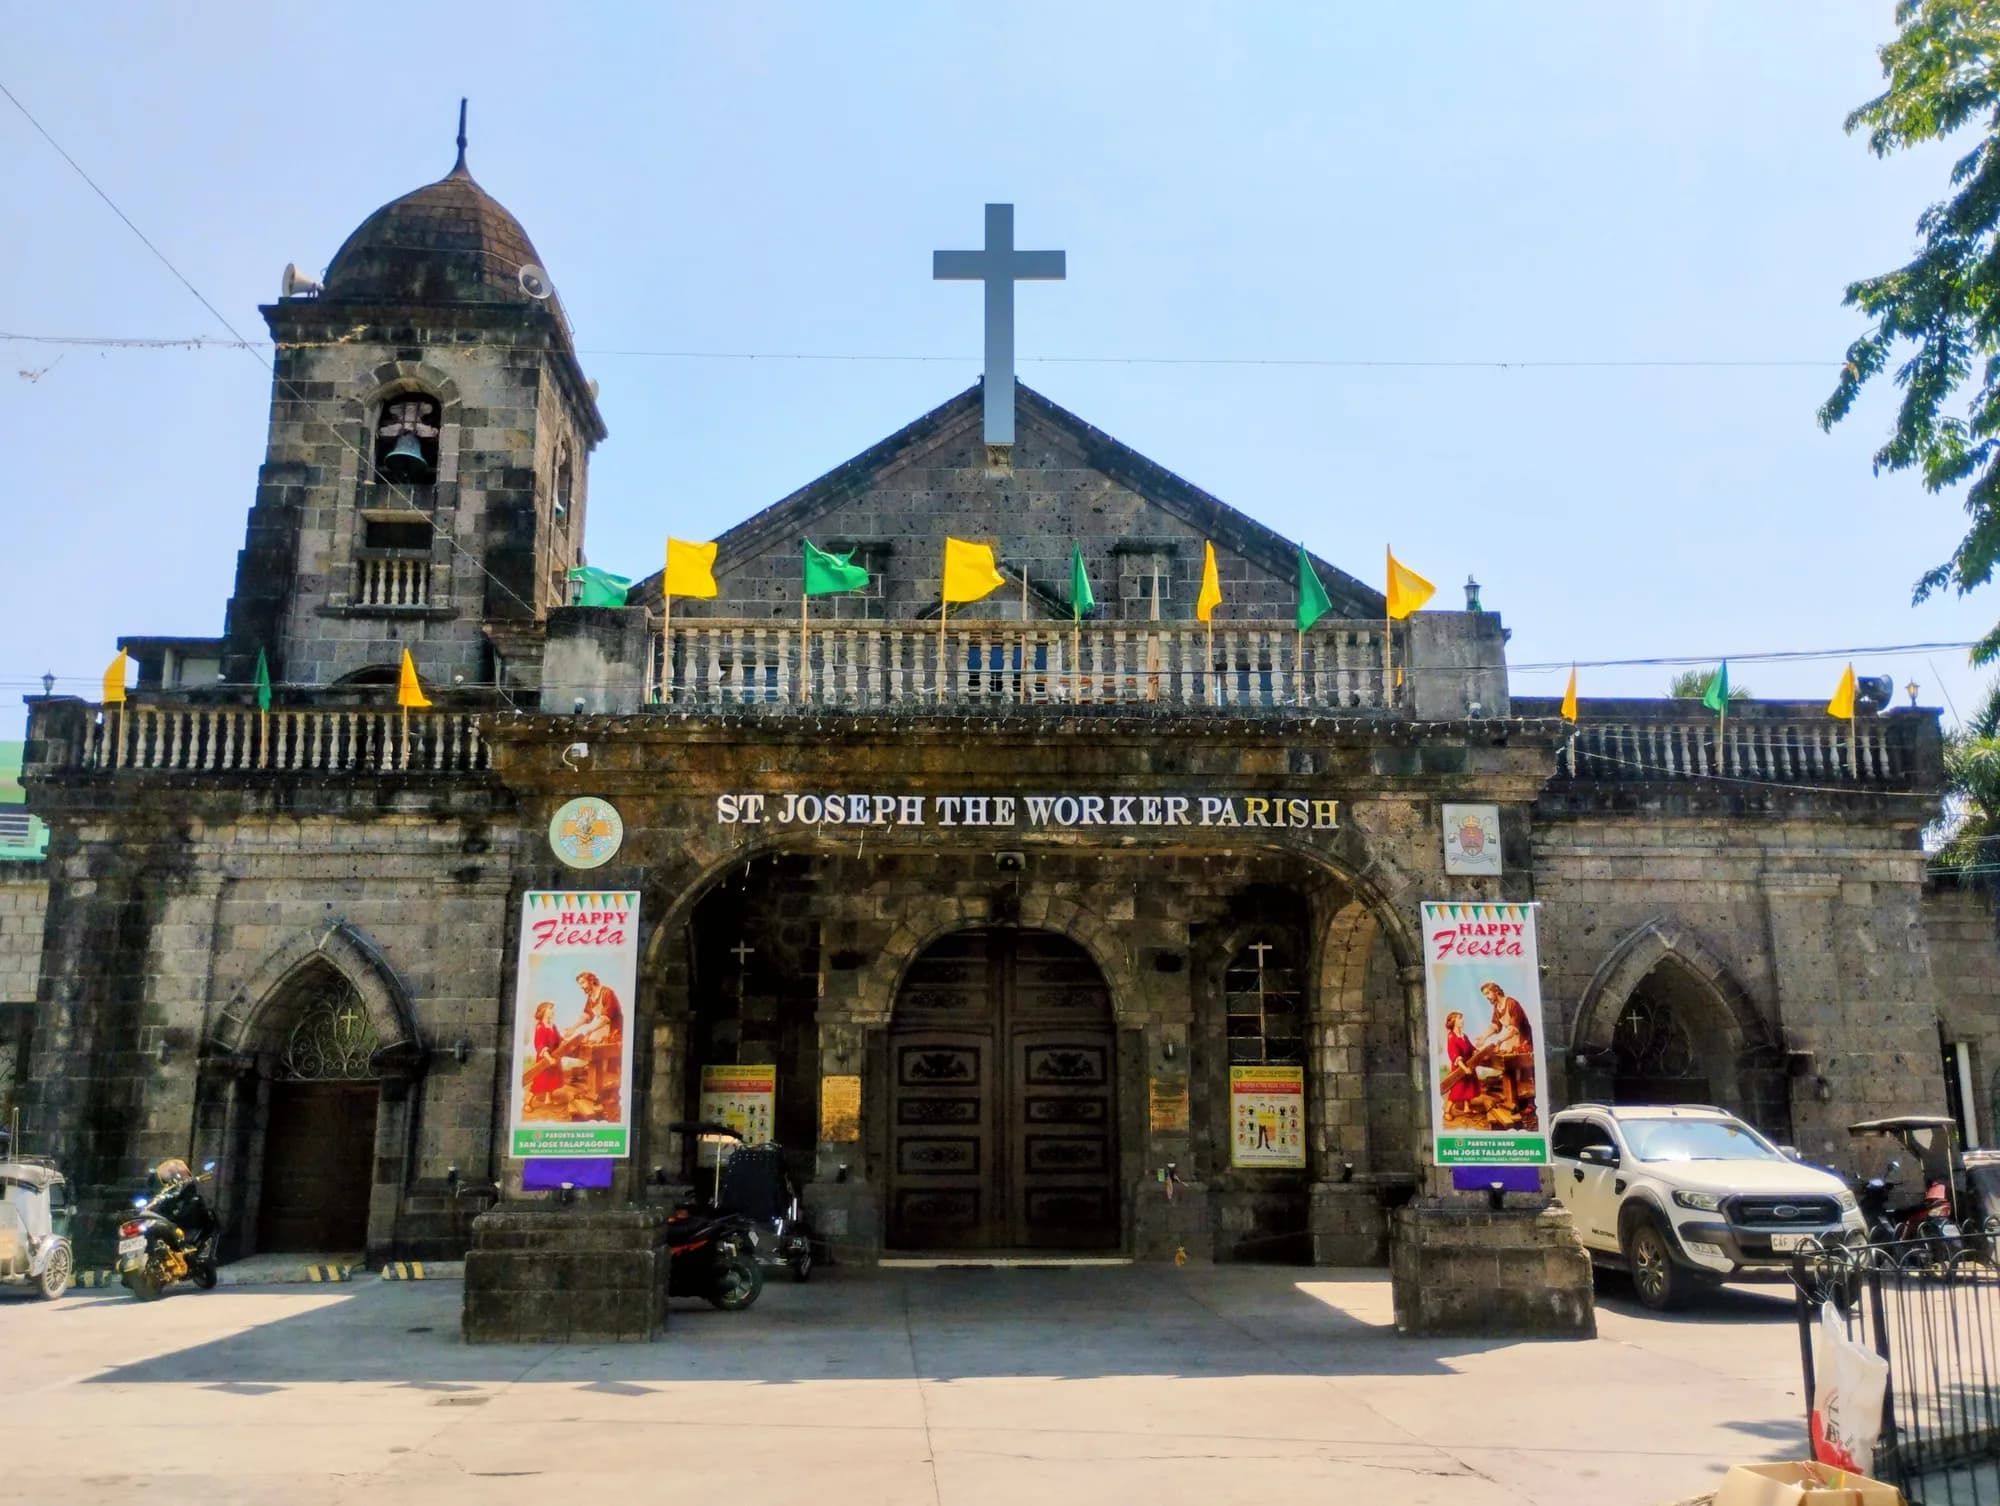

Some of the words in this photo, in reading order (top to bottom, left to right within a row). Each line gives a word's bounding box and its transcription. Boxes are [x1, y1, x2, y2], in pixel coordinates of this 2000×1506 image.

[717, 793, 771, 825] ST.
[778, 793, 927, 826] JOSEPH
[935, 796, 1016, 826] THE
[1023, 796, 1193, 827] WORKER
[1198, 796, 1340, 830] PARISH
[561, 911, 628, 925] HAPPY
[531, 918, 626, 951] Fiesta
[1458, 923, 1525, 936] HAPPY
[1432, 929, 1524, 961] Fiesta
[519, 1140, 537, 1149] SAN
[538, 1140, 558, 1149] JOSE
[1482, 1149, 1541, 1157] TALAPAGOBRA
